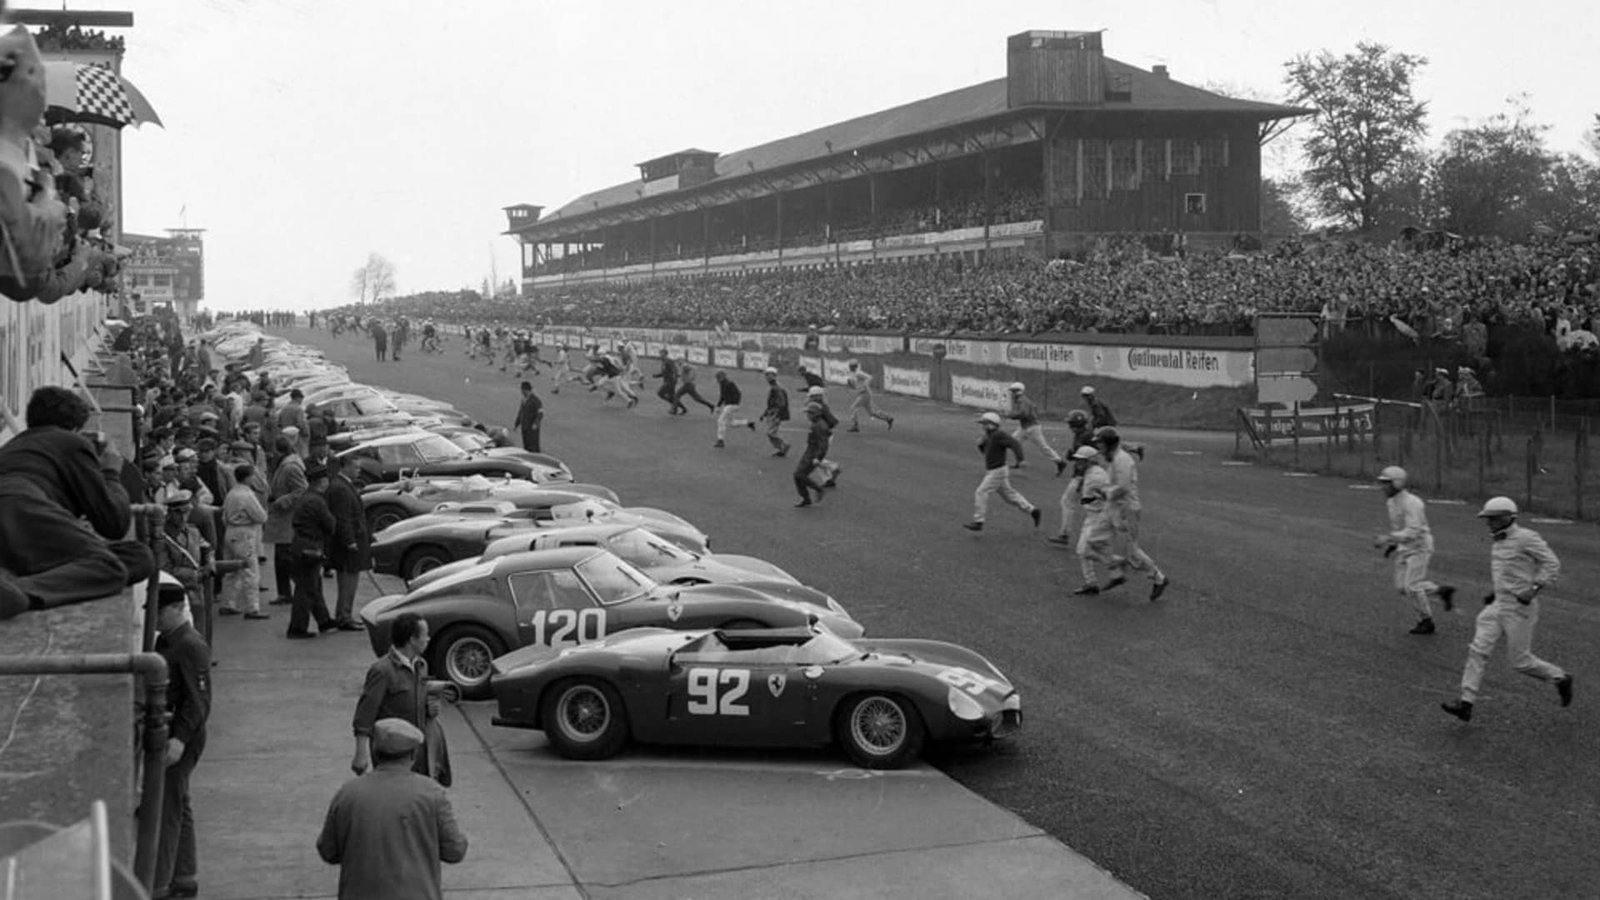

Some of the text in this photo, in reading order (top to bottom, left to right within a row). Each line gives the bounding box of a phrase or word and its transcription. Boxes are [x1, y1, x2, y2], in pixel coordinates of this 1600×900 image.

[1006, 342, 1074, 362] Continental Reifen
[1127, 347, 1220, 372] Continental Reifen
[531, 607, 607, 648] 120
[687, 667, 751, 716] 92
